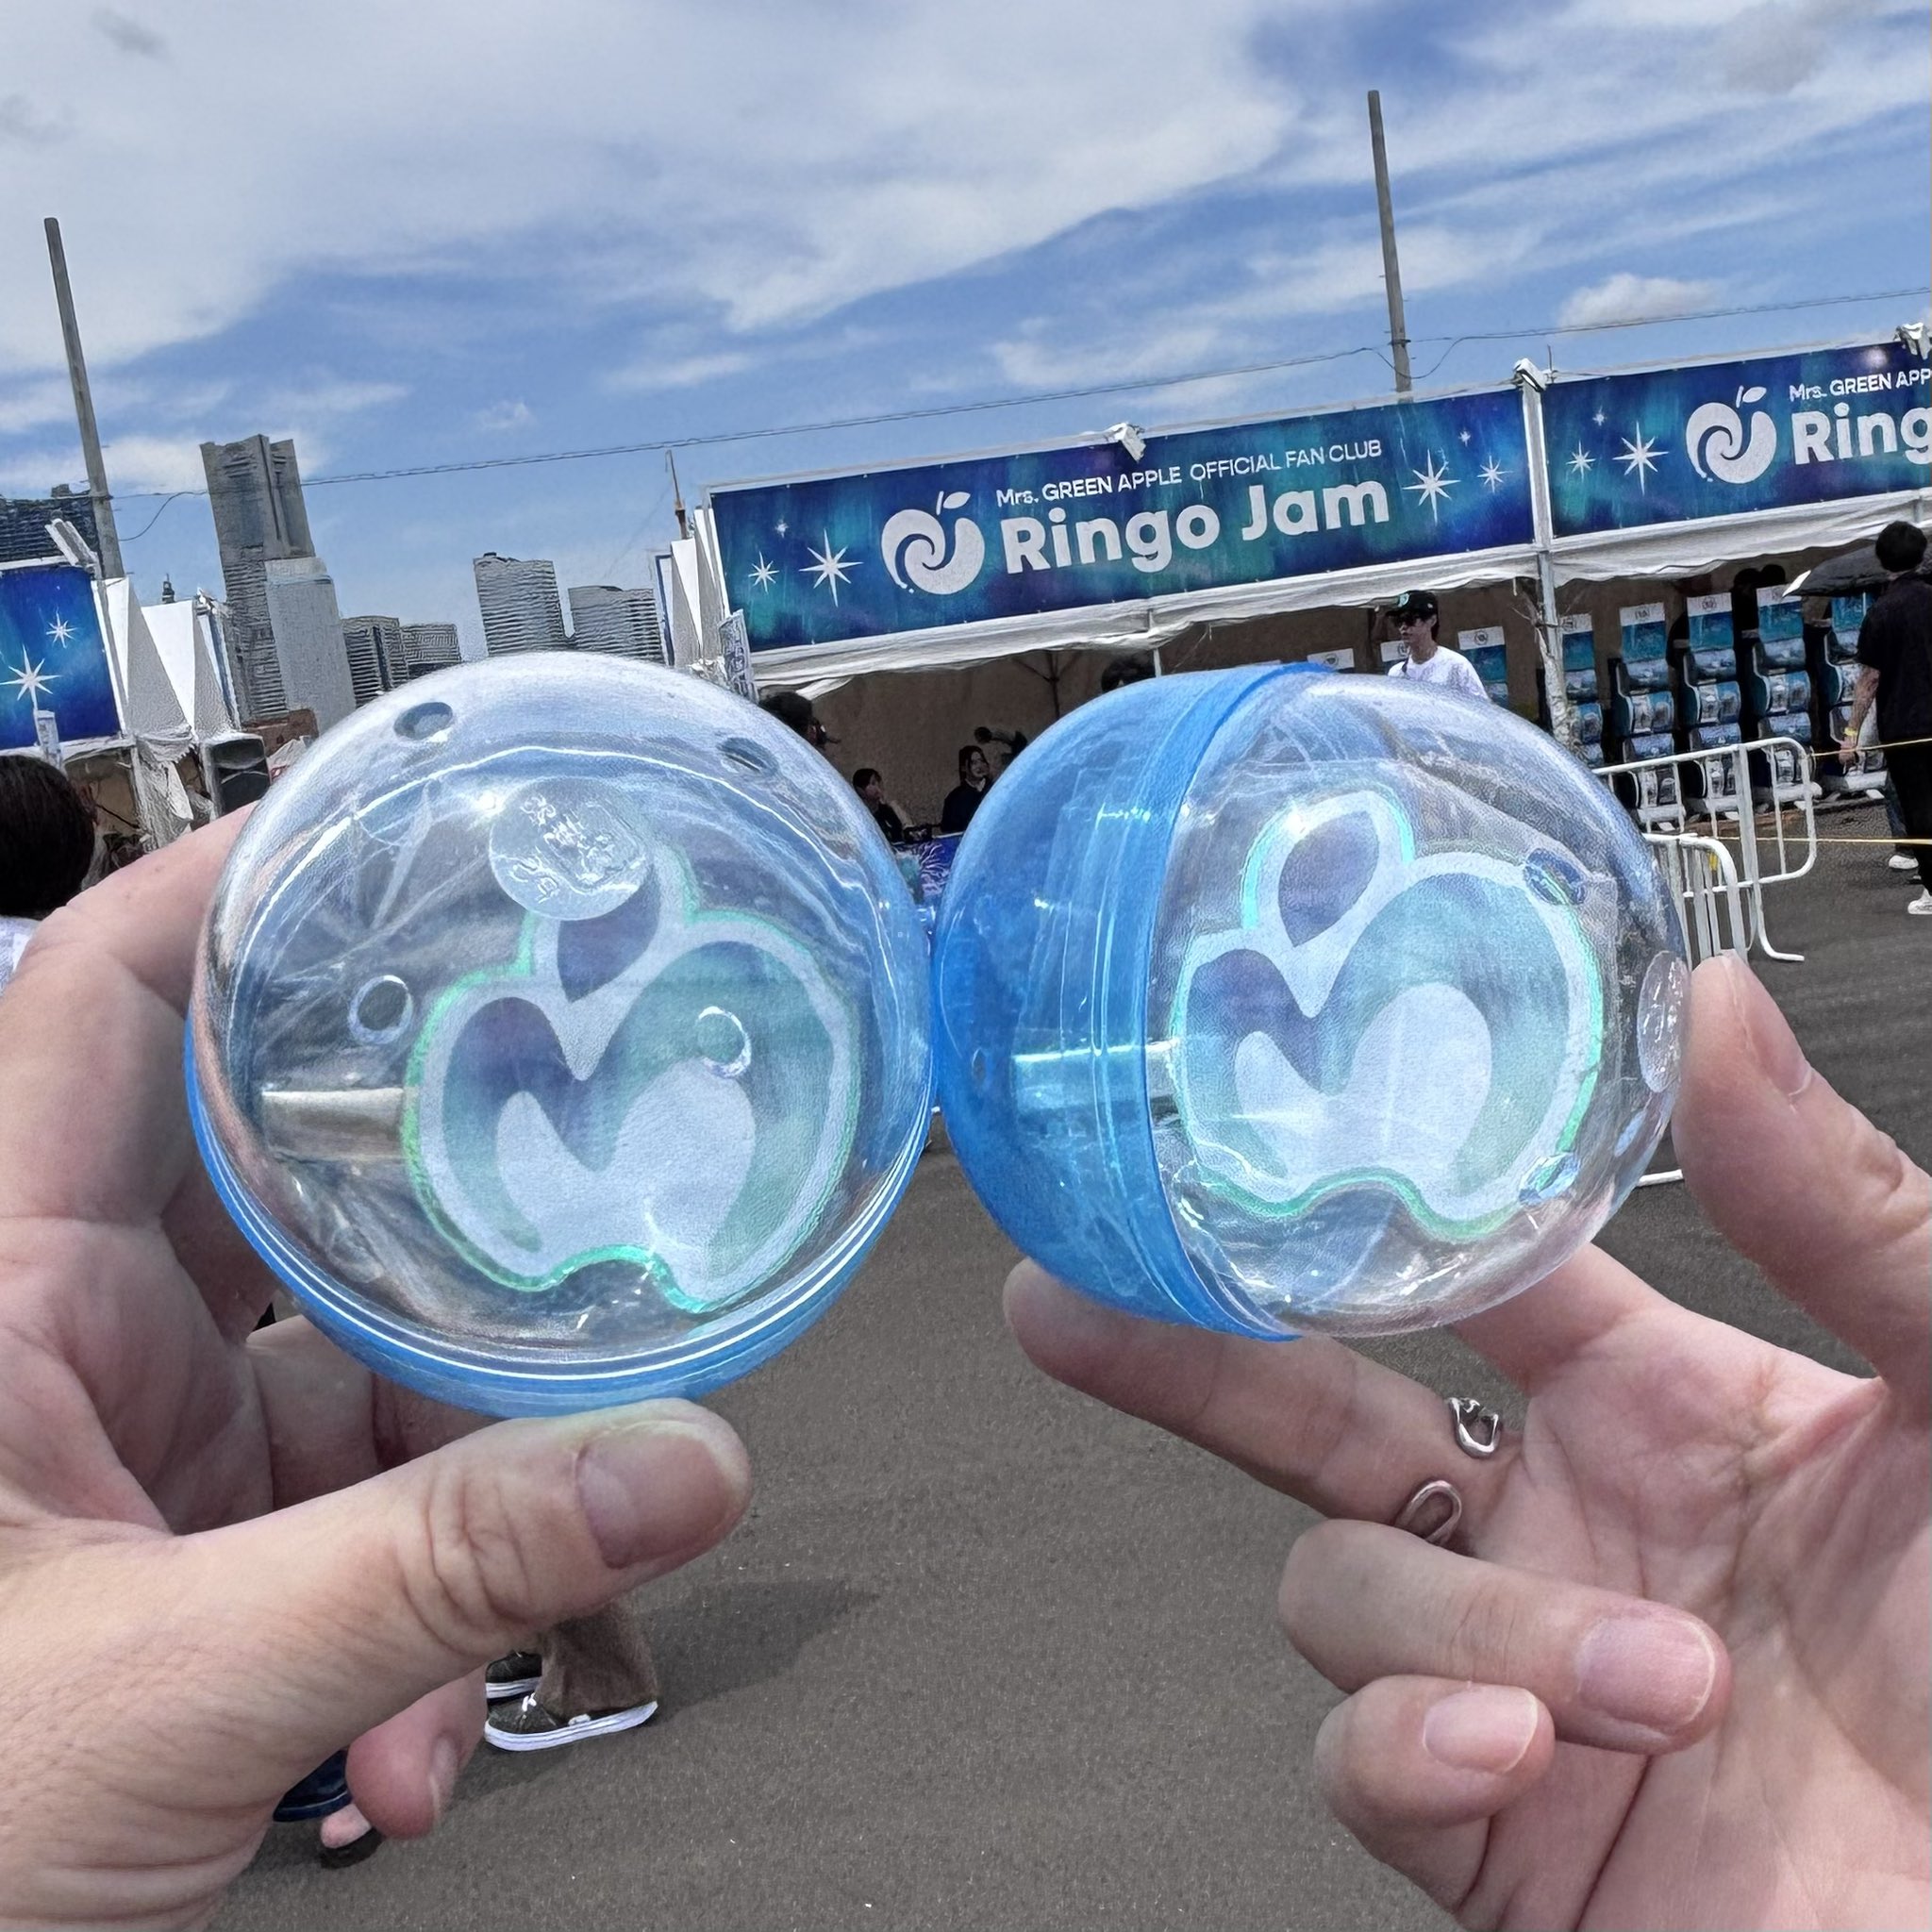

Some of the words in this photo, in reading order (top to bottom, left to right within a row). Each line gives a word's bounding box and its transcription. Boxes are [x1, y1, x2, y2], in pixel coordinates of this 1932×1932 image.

[1789, 383, 1827, 402] Mrs.
[1829, 373, 1891, 396] GREEN
[1791, 402, 1932, 465] Ring
[995, 489, 1039, 507] Mrs.
[1041, 475, 1113, 500] GREEN
[1118, 466, 1182, 492] APPLE
[1190, 453, 1283, 481] OFFICIAL
[1285, 447, 1325, 468] FAN
[1328, 440, 1382, 462] CLUB
[1000, 505, 1221, 574] Ringo
[1241, 480, 1390, 541] Jam
